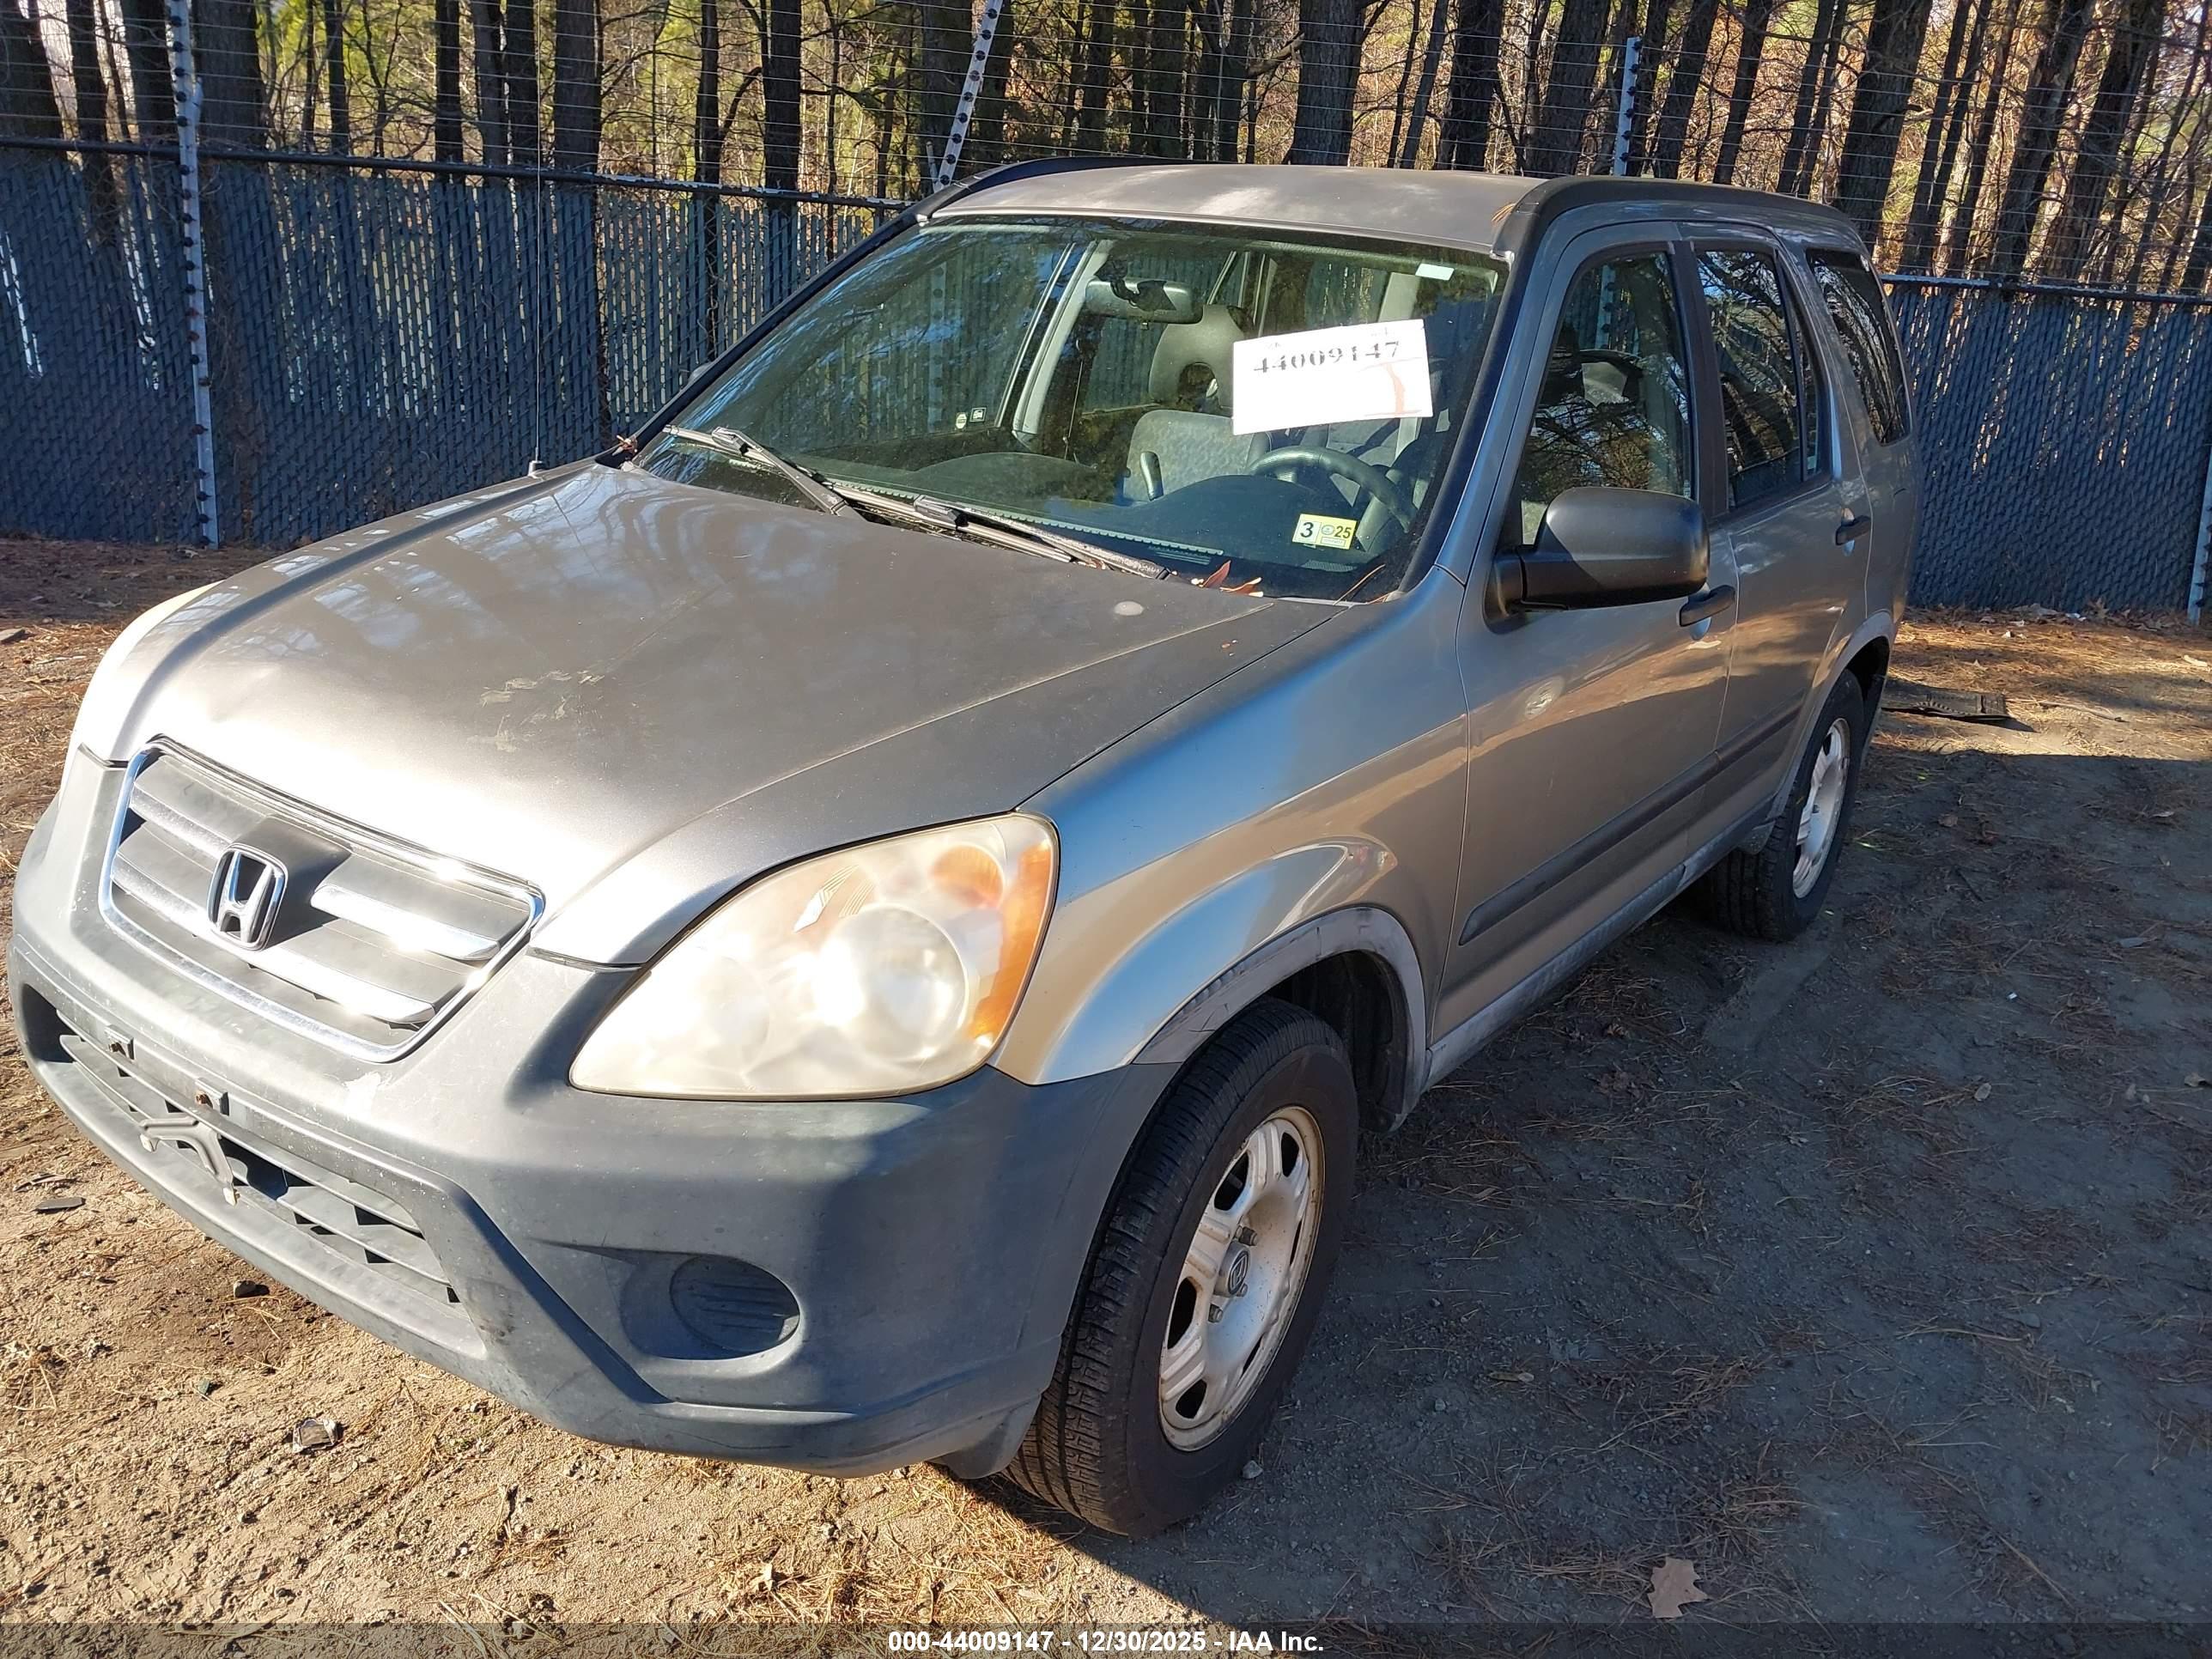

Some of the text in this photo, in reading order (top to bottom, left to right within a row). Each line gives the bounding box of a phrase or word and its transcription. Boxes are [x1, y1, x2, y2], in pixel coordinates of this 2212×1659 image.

[1253, 340, 1400, 374] 44009147
[1300, 521, 1314, 538] 3
[1334, 525, 1352, 539] 25
